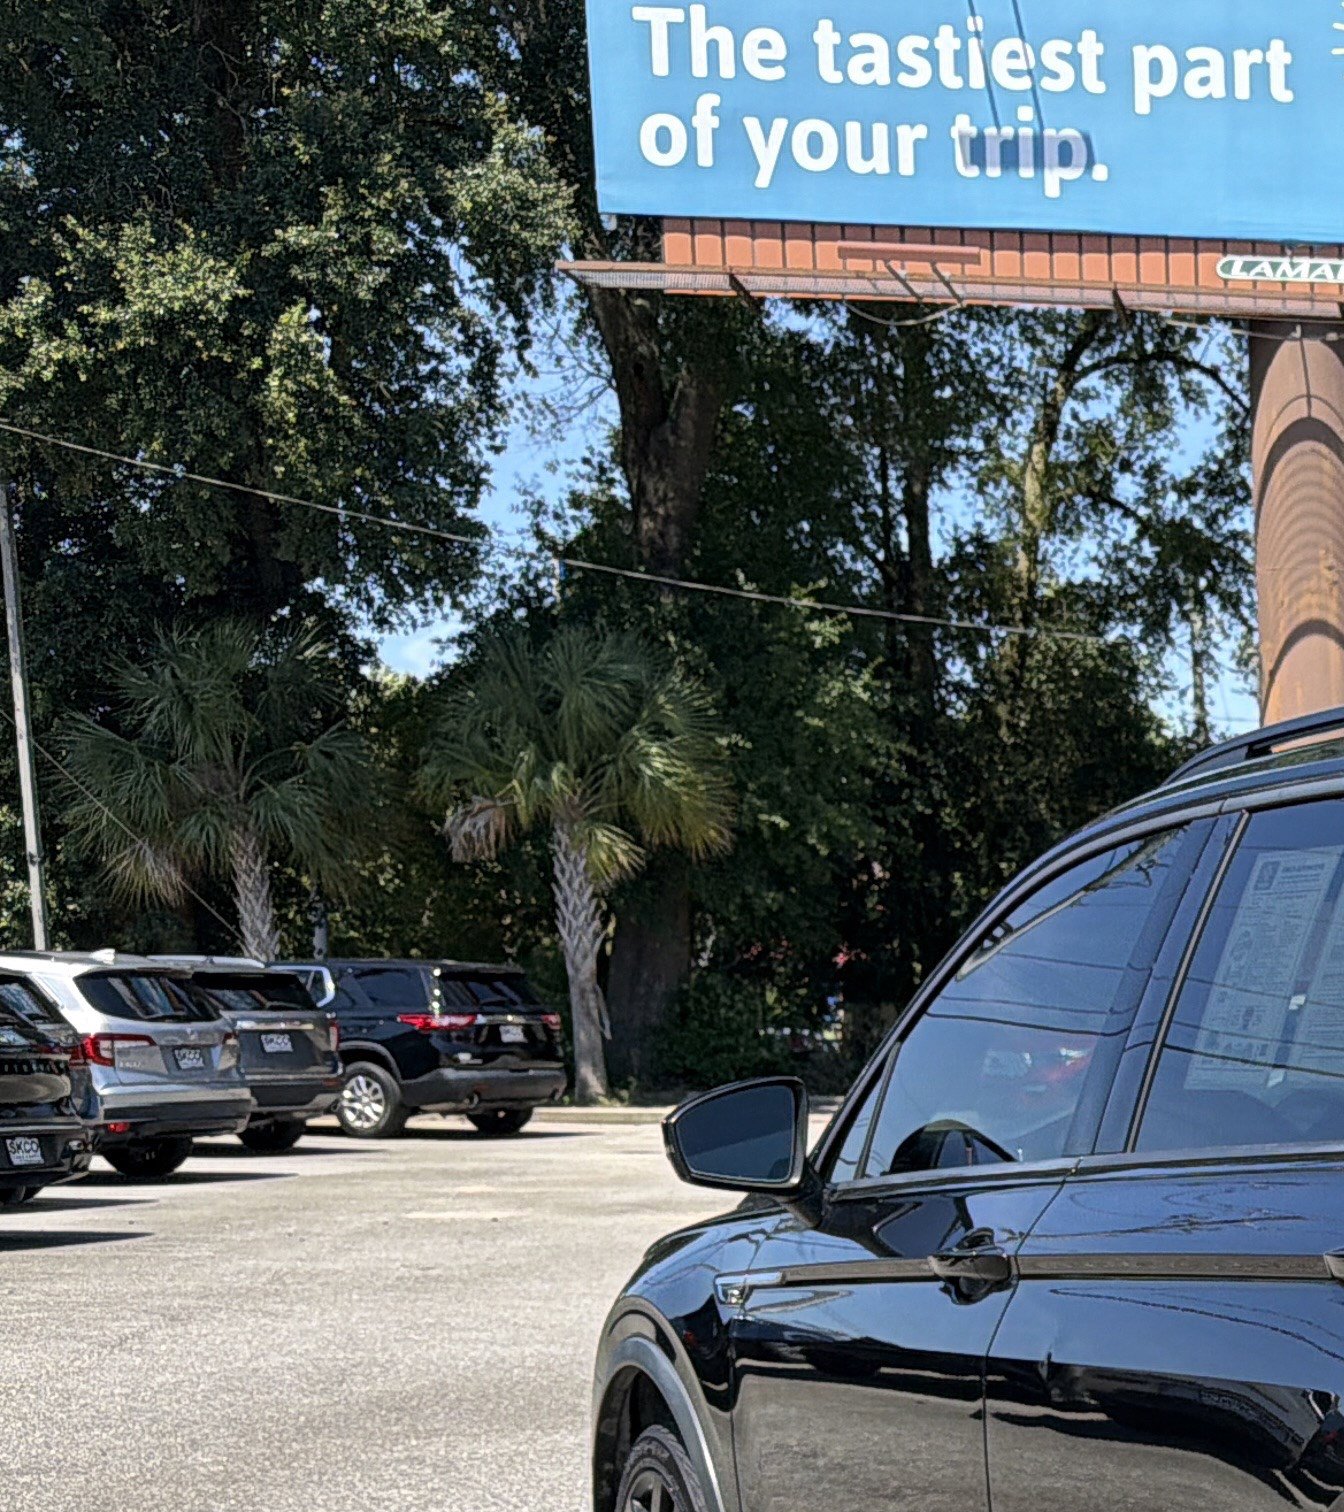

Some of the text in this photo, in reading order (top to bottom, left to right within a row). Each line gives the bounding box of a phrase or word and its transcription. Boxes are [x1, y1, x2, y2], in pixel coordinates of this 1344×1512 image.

[633, 5, 1294, 115] The tastiest part
[640, 94, 1109, 199] of your trip.
